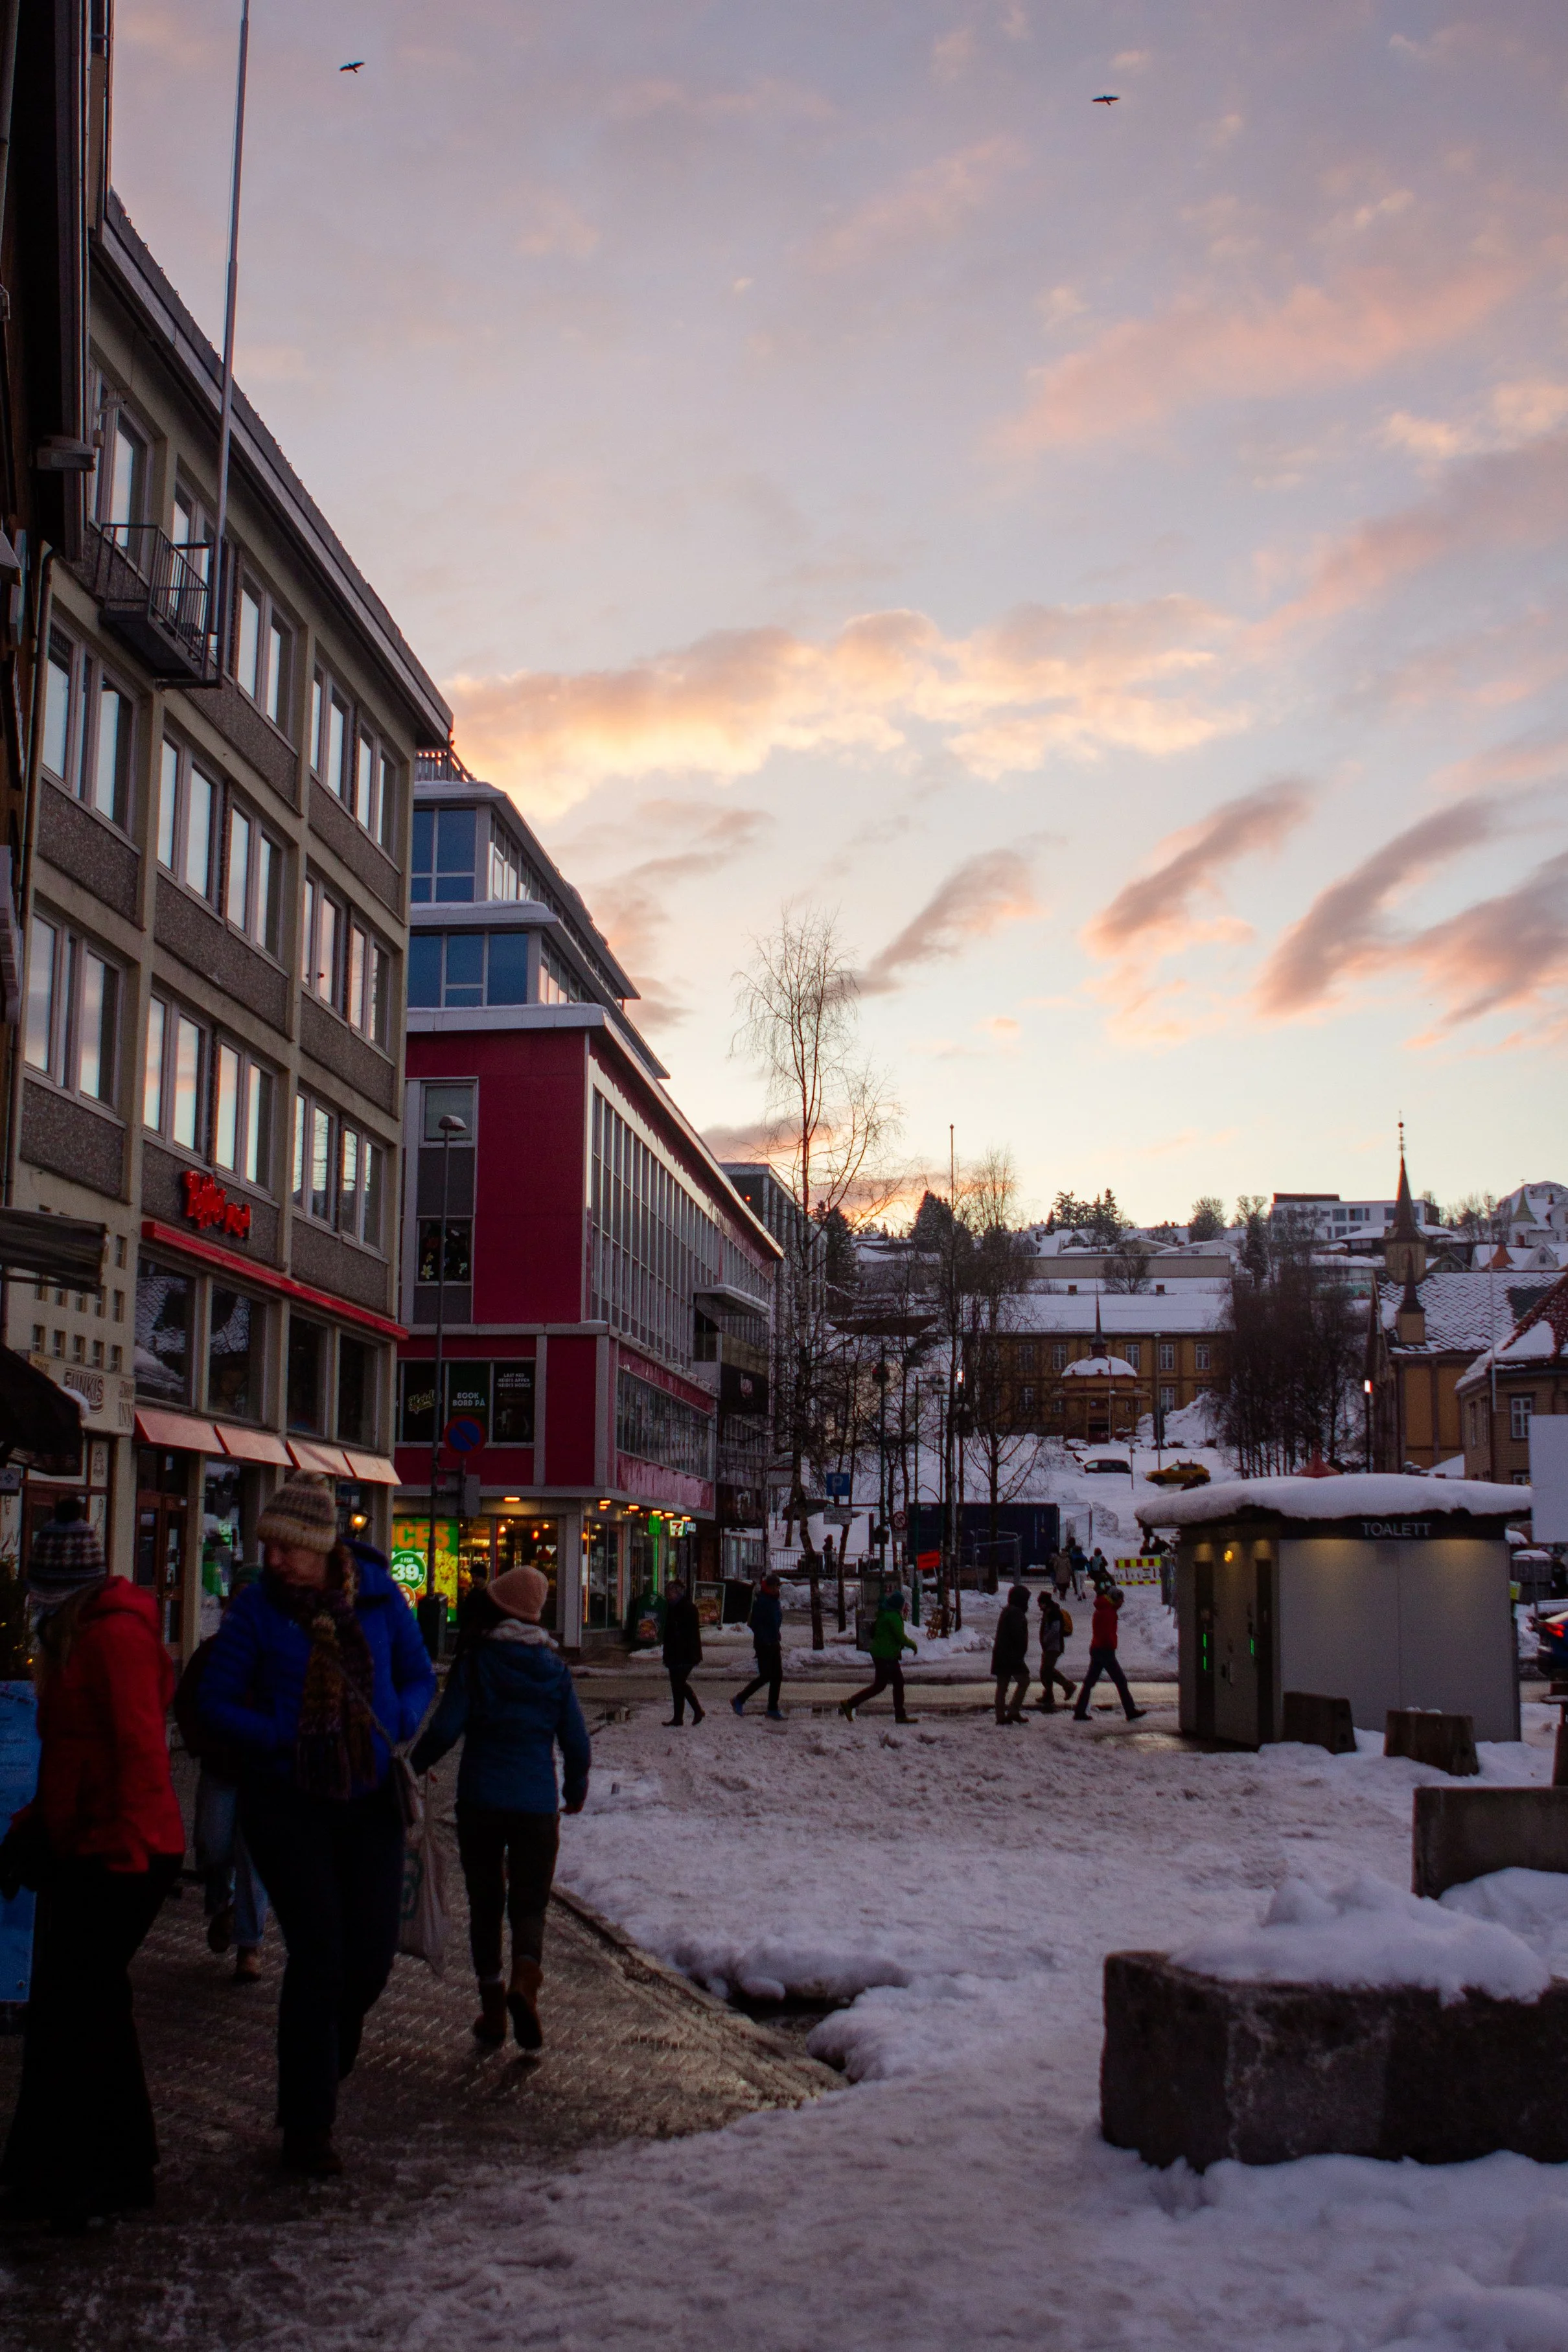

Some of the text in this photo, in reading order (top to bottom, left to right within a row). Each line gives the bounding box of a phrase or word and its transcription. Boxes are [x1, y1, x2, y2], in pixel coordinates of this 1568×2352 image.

[474, 1398, 486, 1407] PÅ
[833, 1475, 843, 1492] P
[1360, 1521, 1432, 1537] TOALETT
